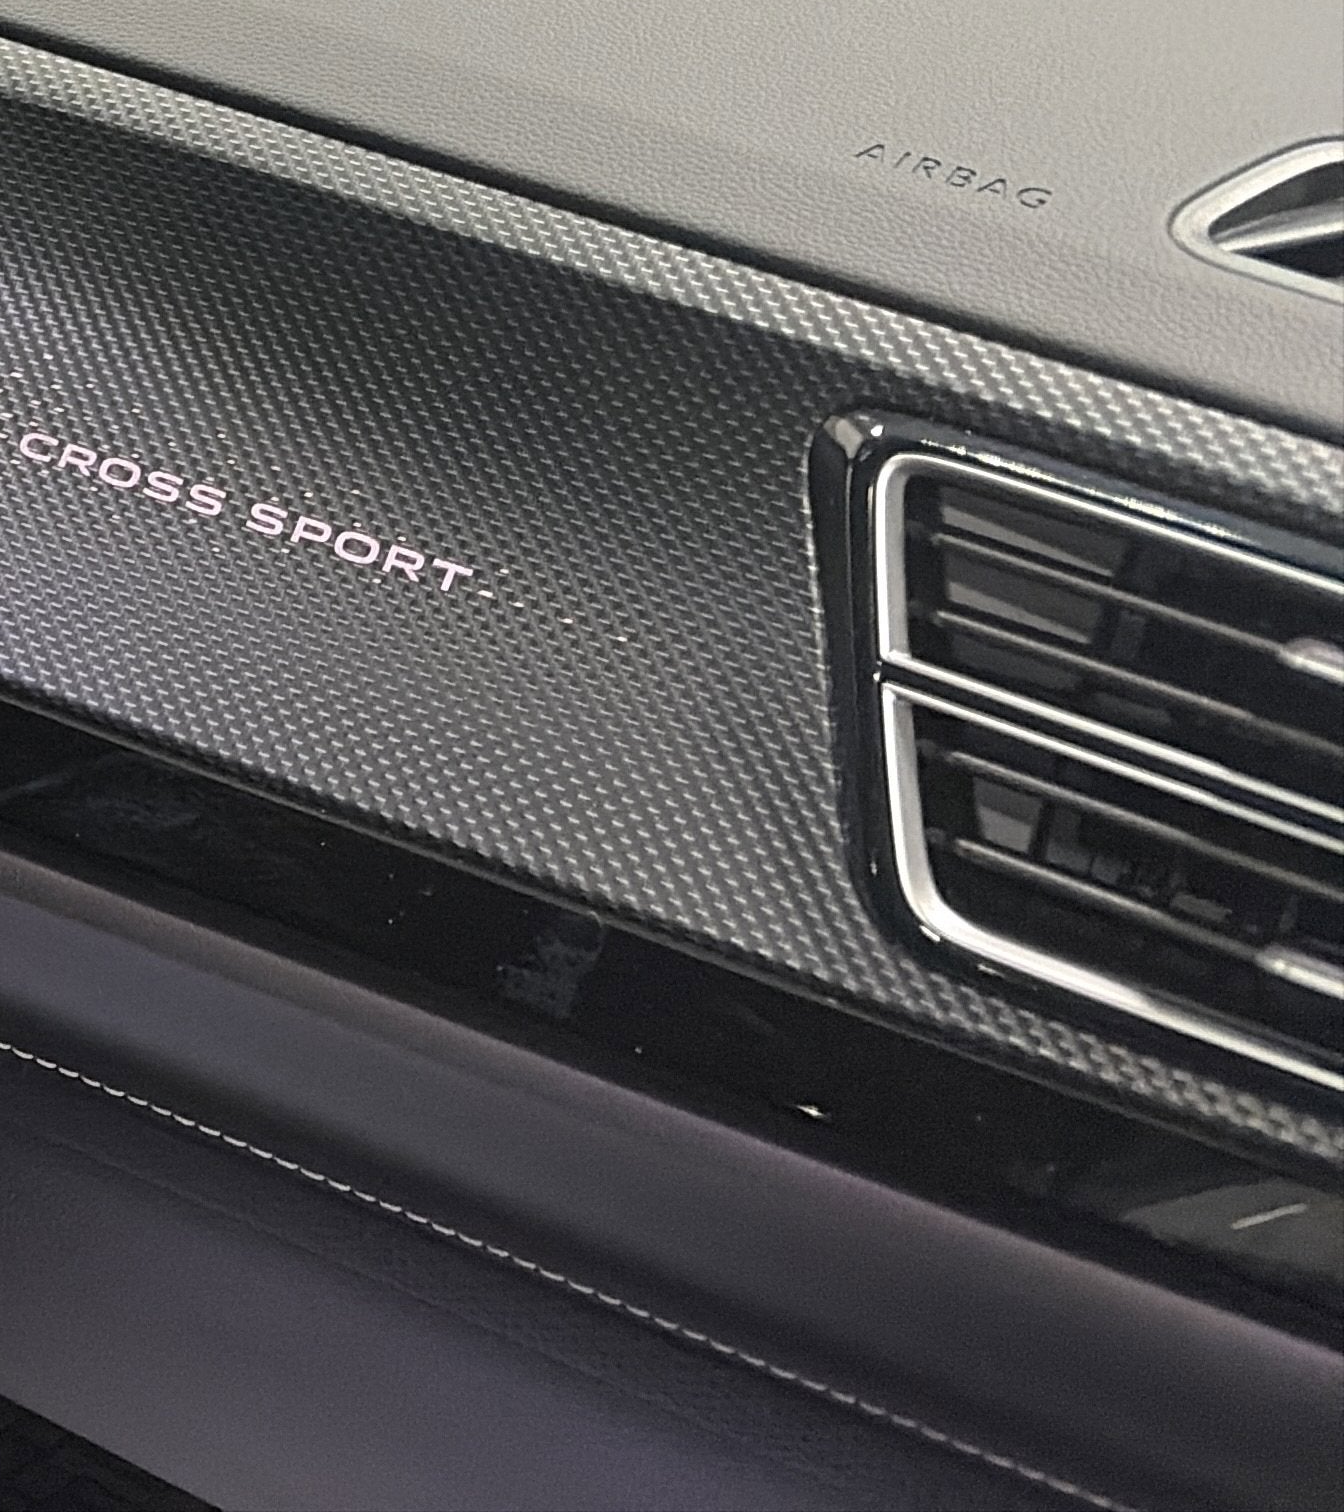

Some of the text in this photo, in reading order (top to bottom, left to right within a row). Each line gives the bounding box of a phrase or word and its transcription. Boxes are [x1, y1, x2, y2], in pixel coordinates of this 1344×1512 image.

[853, 143, 1054, 210] AIRBAG
[18, 432, 474, 592] CROSS SPORT
